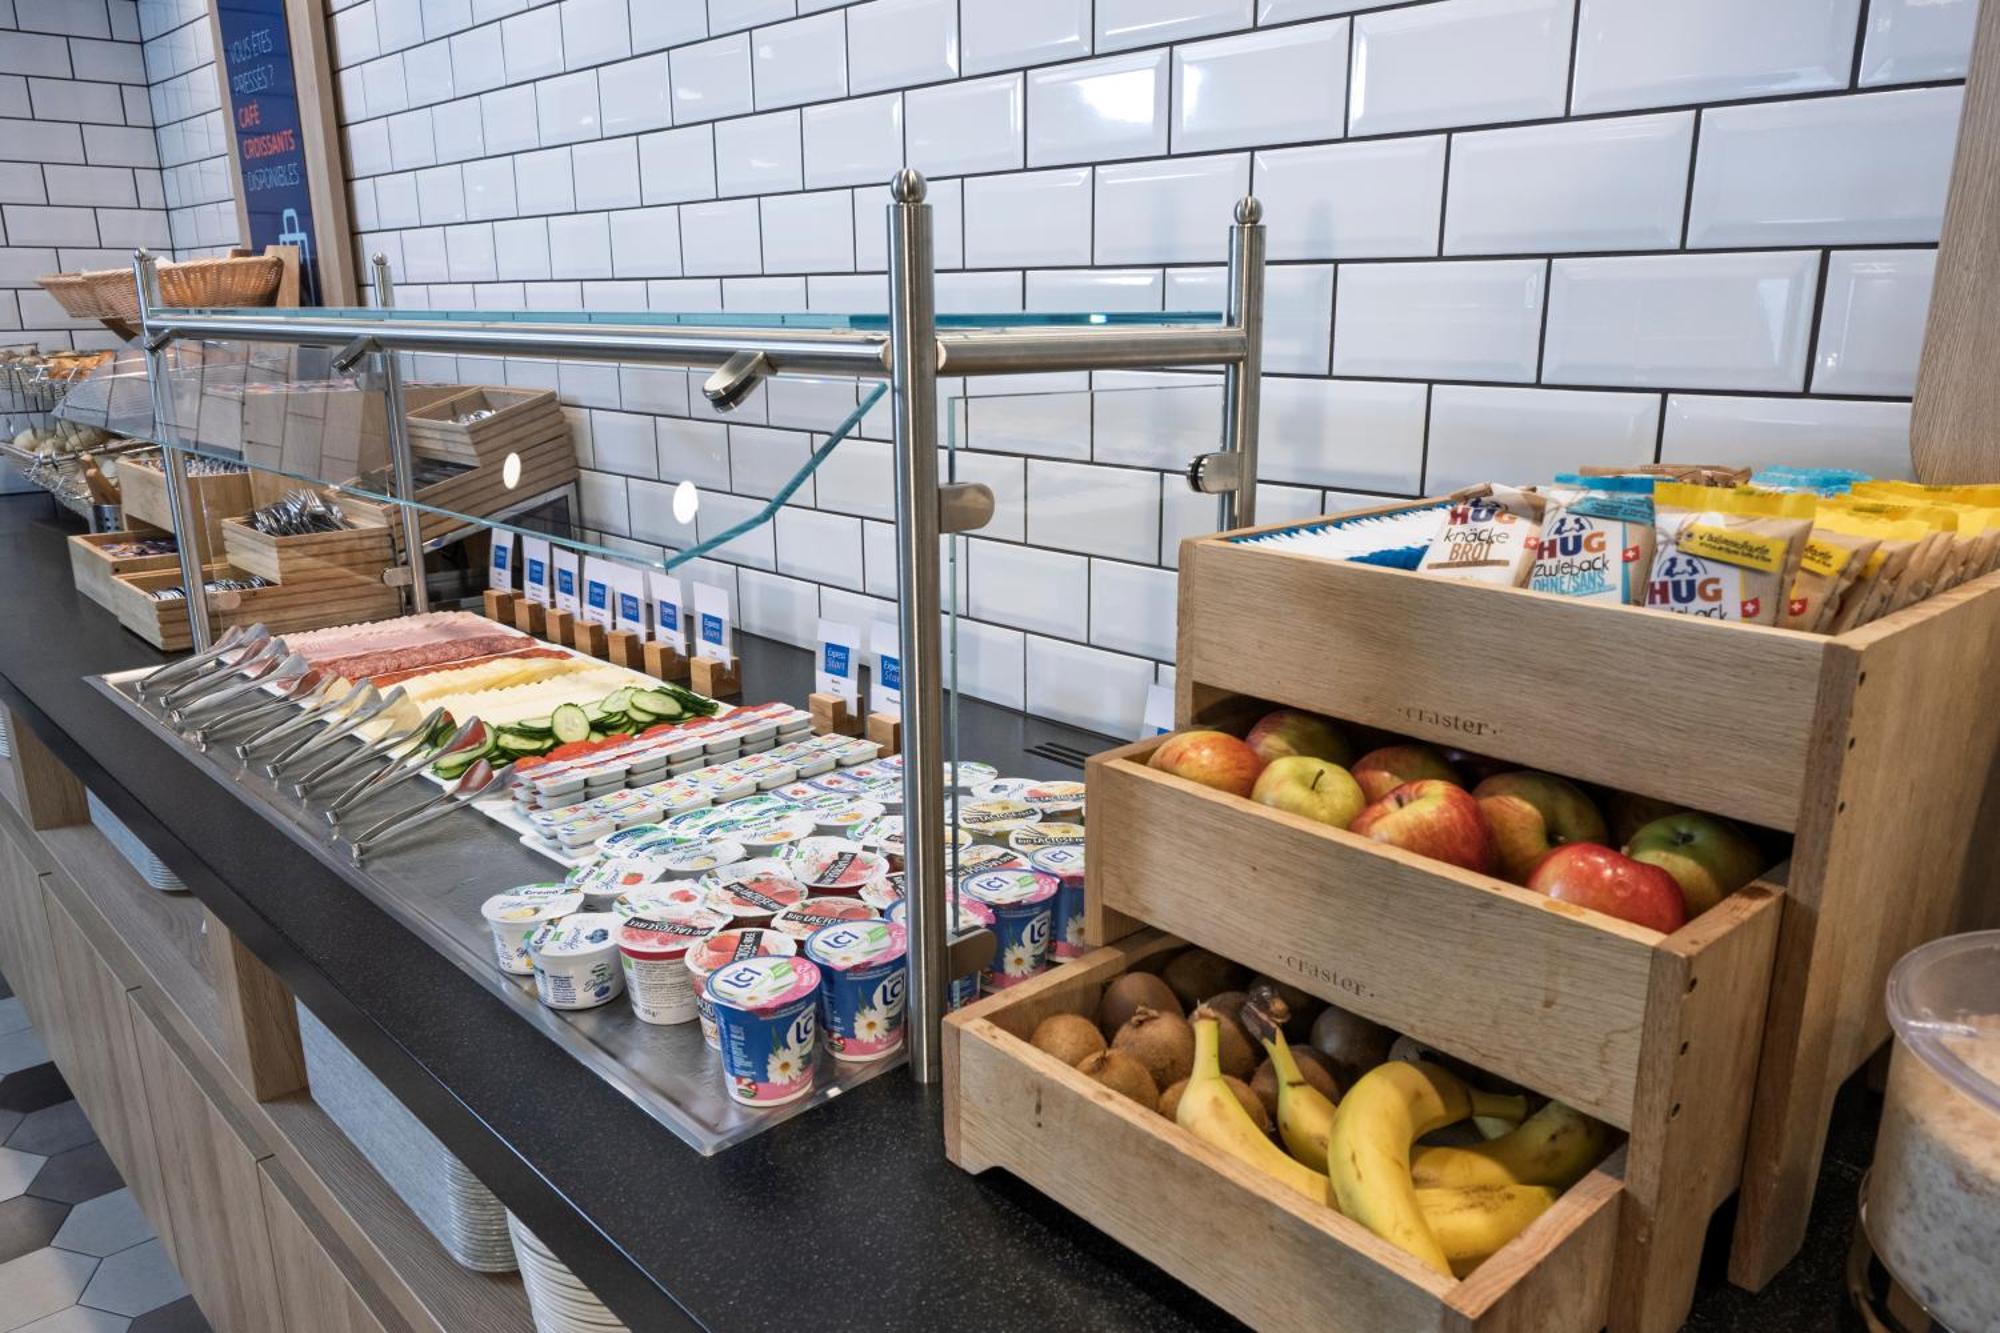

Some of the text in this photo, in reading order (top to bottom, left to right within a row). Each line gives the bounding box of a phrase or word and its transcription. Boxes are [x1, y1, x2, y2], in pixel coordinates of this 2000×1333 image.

[238, 100, 261, 128] CAFÉ
[243, 128, 297, 160] CROISSANTS
[246, 162, 300, 191] DISPONIBLES
[1448, 506, 1518, 526] HUG
[1443, 527, 1510, 545] knäcke
[1536, 531, 1607, 561] HUG
[1449, 541, 1492, 562] BROT
[1534, 553, 1610, 577] zwieback
[1648, 577, 1723, 606] HUG
[821, 930, 860, 949] LC1
[721, 966, 762, 989] LC1
